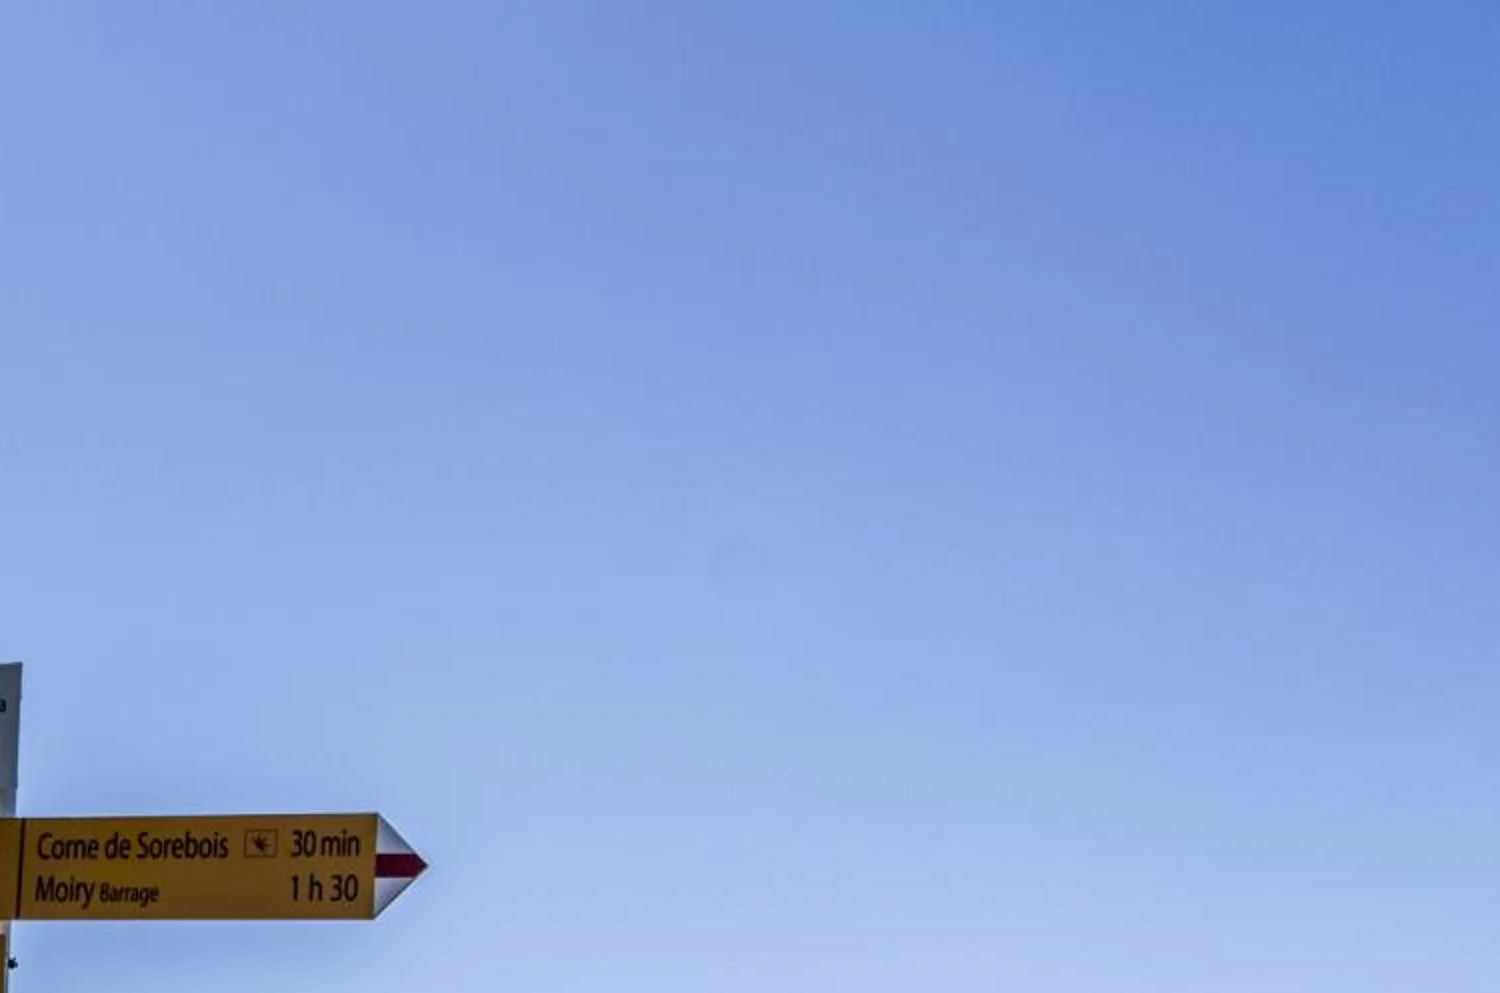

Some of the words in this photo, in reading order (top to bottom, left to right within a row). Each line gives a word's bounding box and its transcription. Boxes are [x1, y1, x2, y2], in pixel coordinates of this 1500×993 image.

[104, 832, 133, 859] de
[136, 830, 229, 860] Sorebois
[291, 829, 316, 857] 30
[321, 829, 360, 857] min
[35, 875, 95, 909] Moiry
[99, 882, 160, 907] Barrage
[291, 876, 300, 901] 1
[308, 873, 323, 901] h
[331, 875, 358, 901] 30
